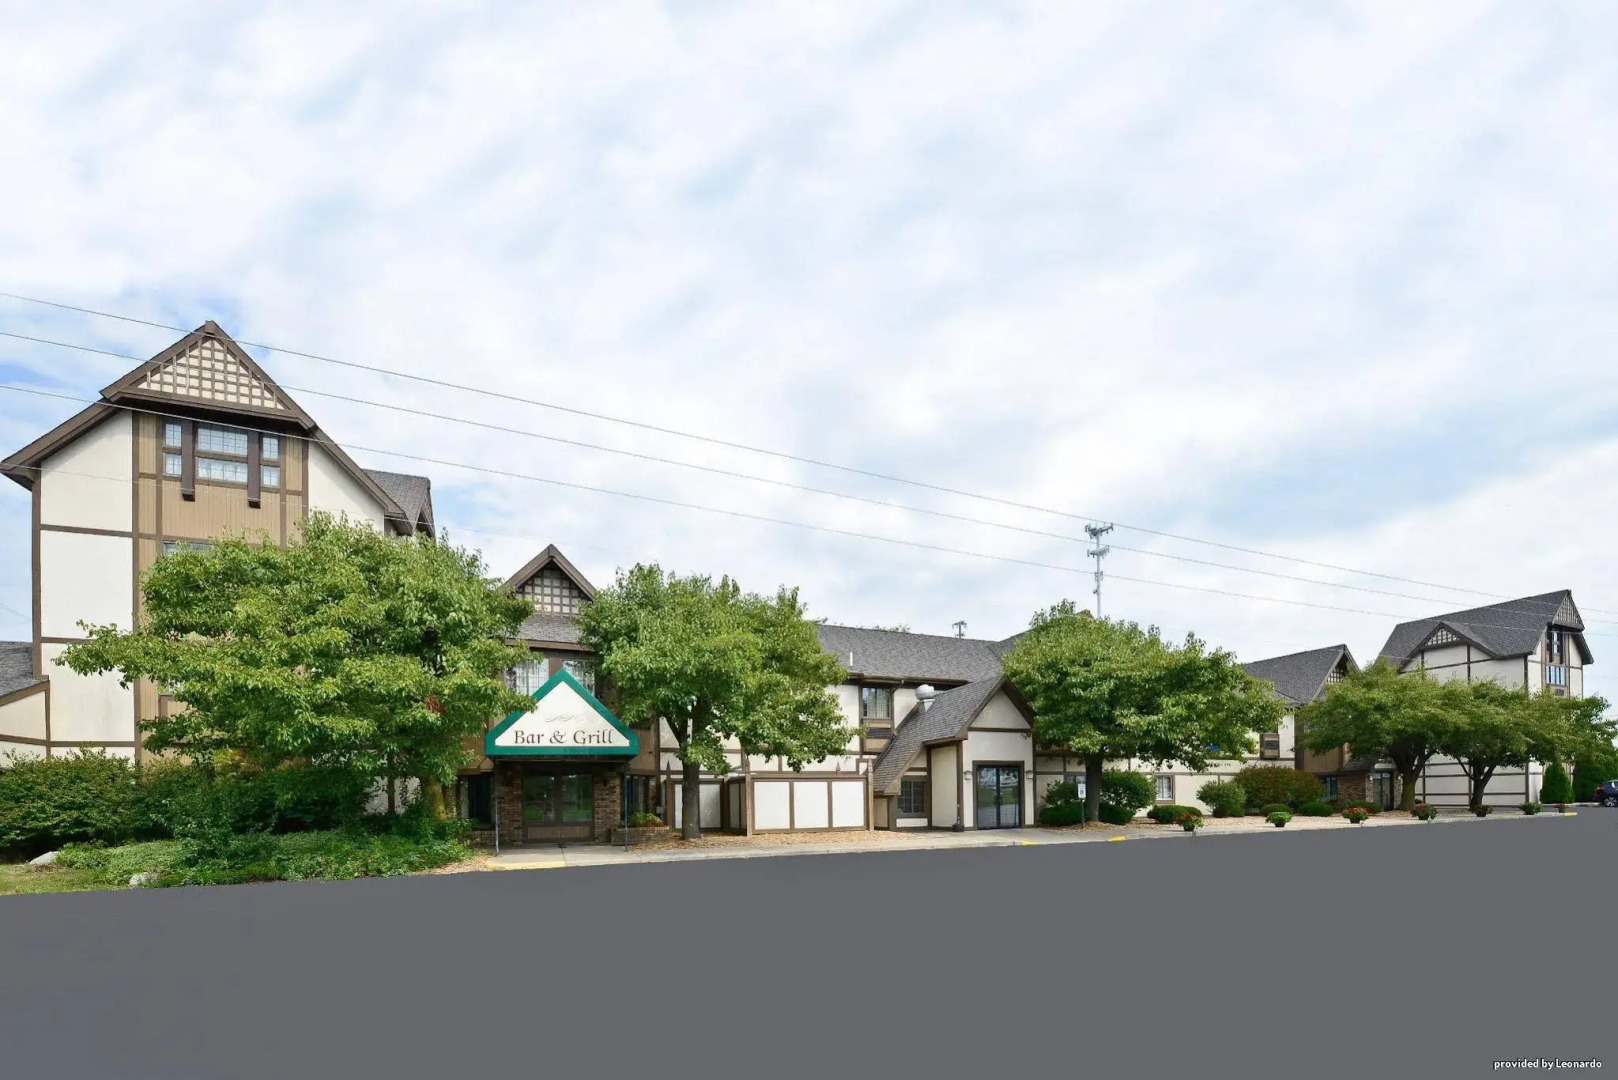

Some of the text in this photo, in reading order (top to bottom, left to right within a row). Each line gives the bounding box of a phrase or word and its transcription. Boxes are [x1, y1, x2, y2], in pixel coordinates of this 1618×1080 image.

[514, 729, 614, 745] Bar & Grill
